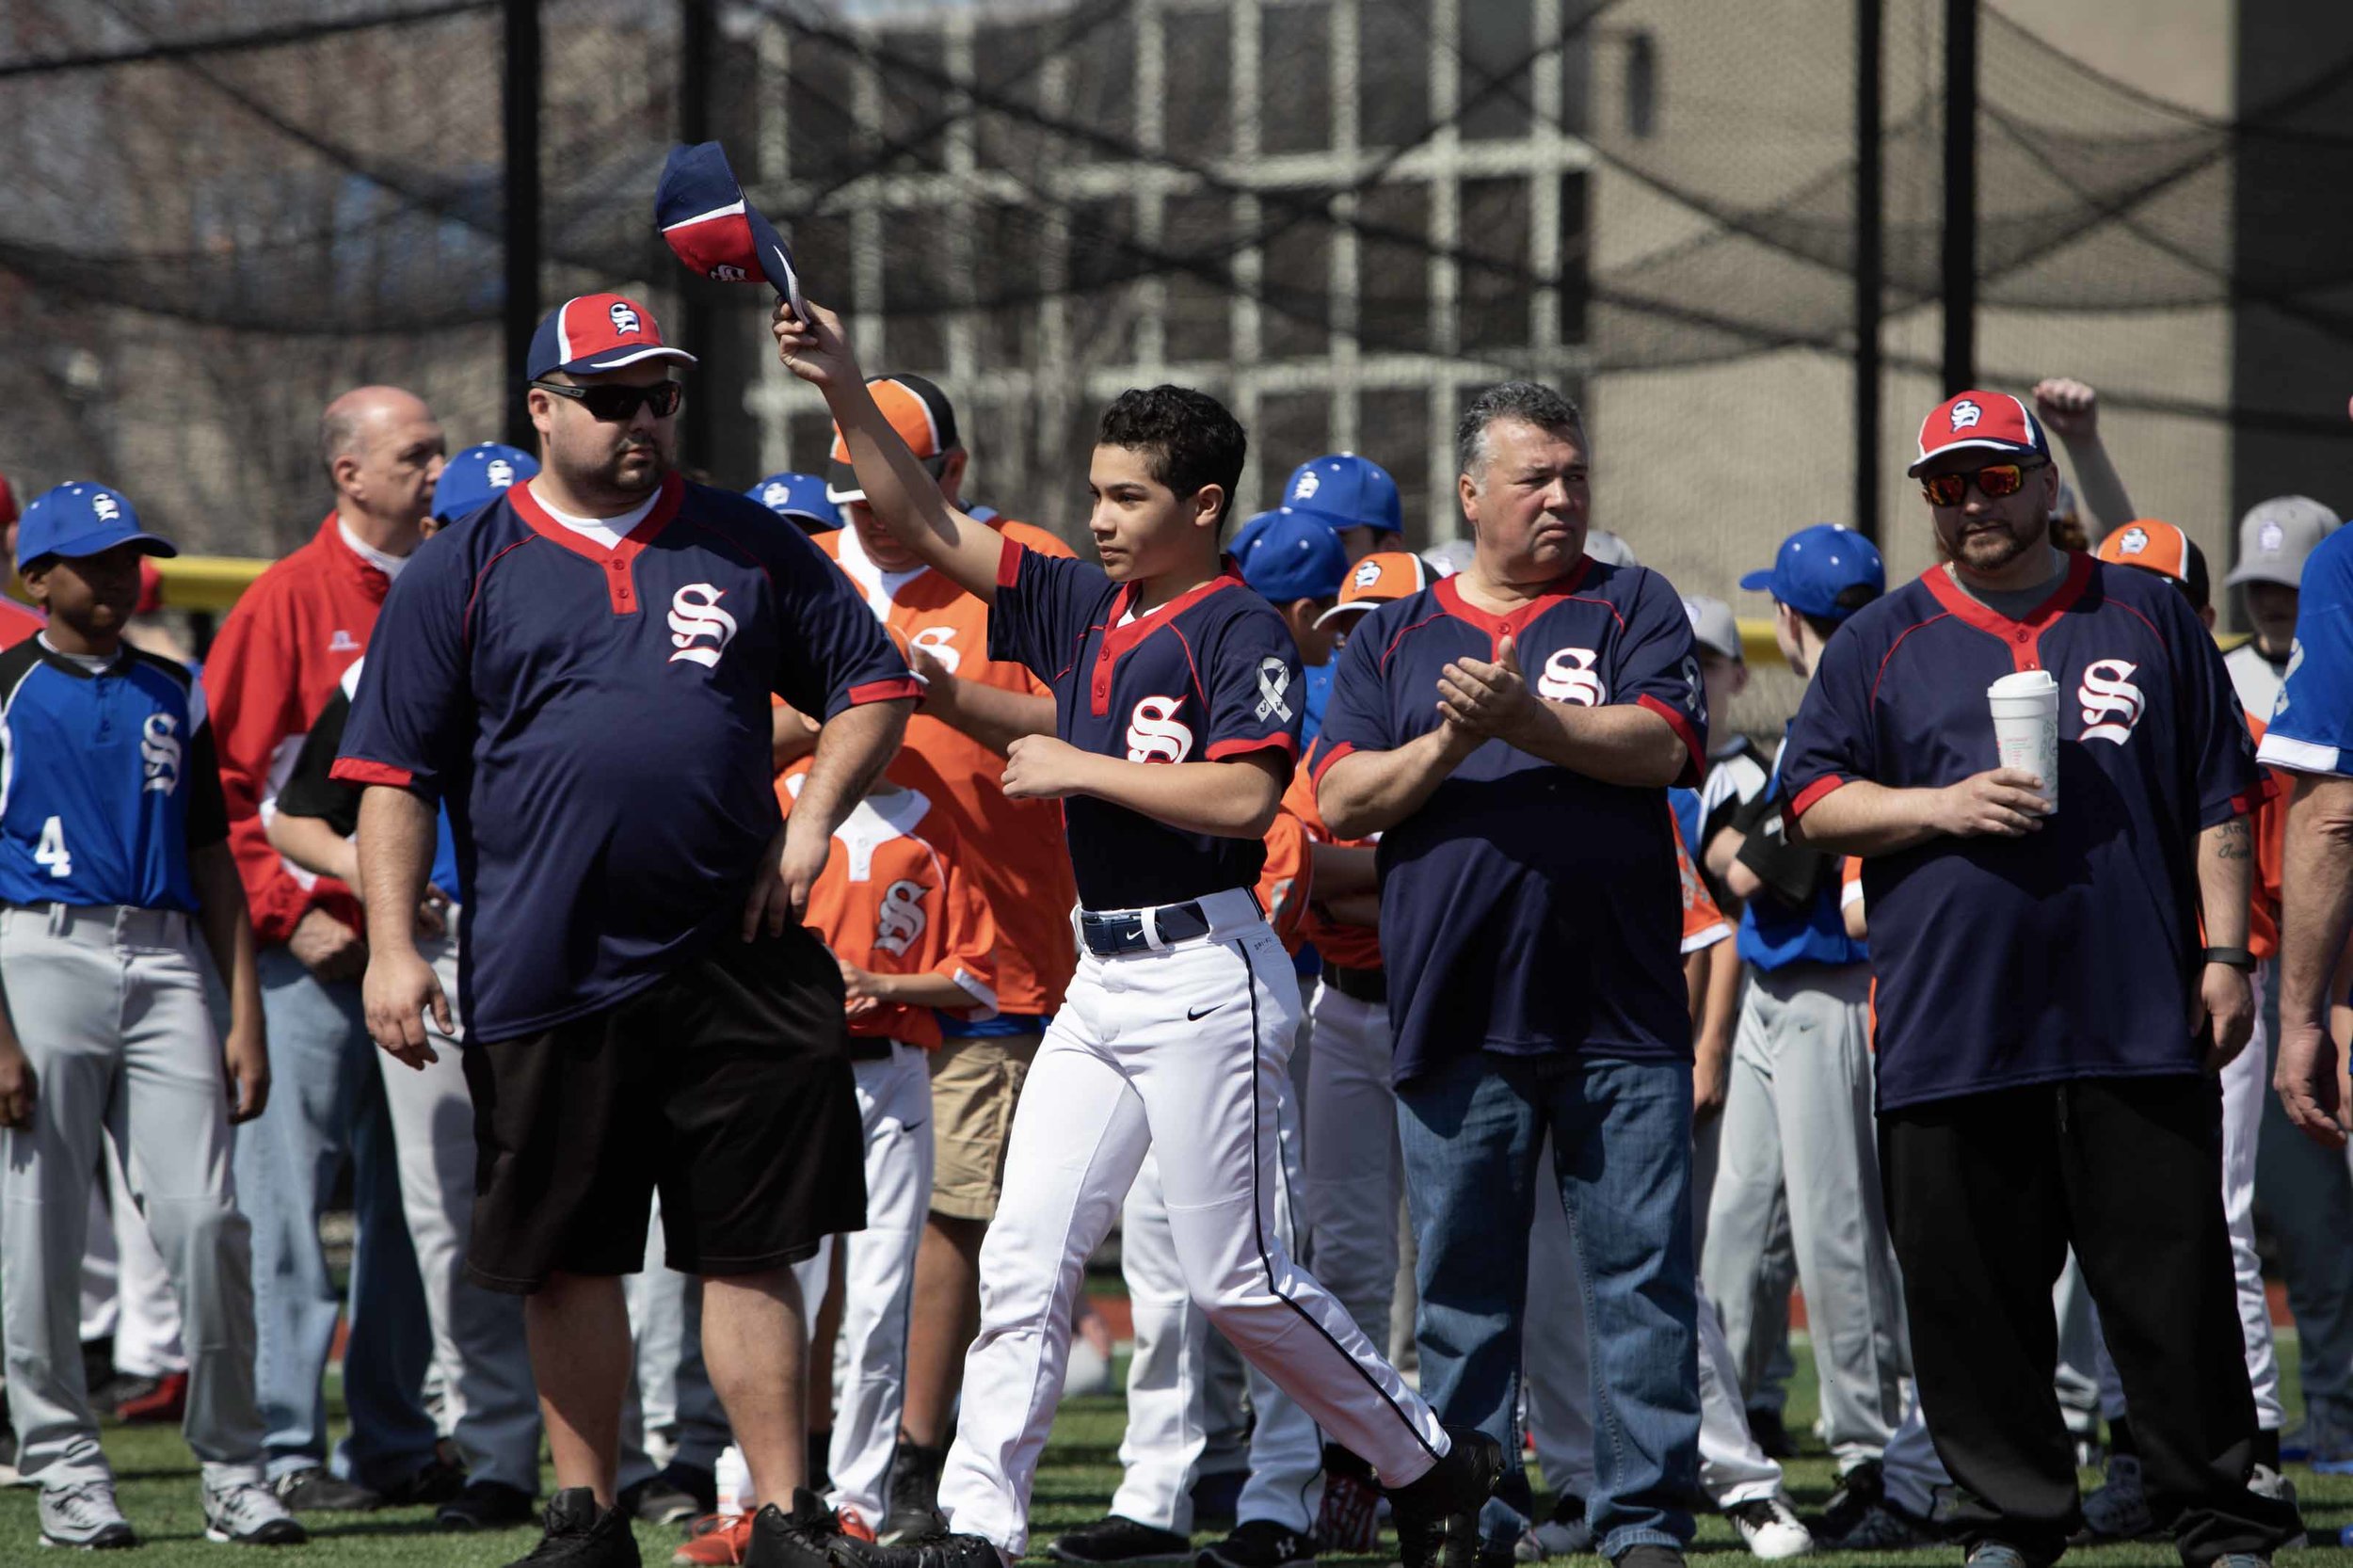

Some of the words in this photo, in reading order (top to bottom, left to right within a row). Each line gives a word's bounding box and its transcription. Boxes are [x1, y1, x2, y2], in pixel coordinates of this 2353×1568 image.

[609, 302, 642, 336] S
[1950, 399, 1982, 433] S
[92, 493, 120, 522] S
[667, 583, 738, 669] S
[1127, 694, 1194, 765] S
[2077, 658, 2147, 746] S
[140, 712, 183, 797] S
[34, 815, 72, 878] 4
[873, 878, 931, 959] S
